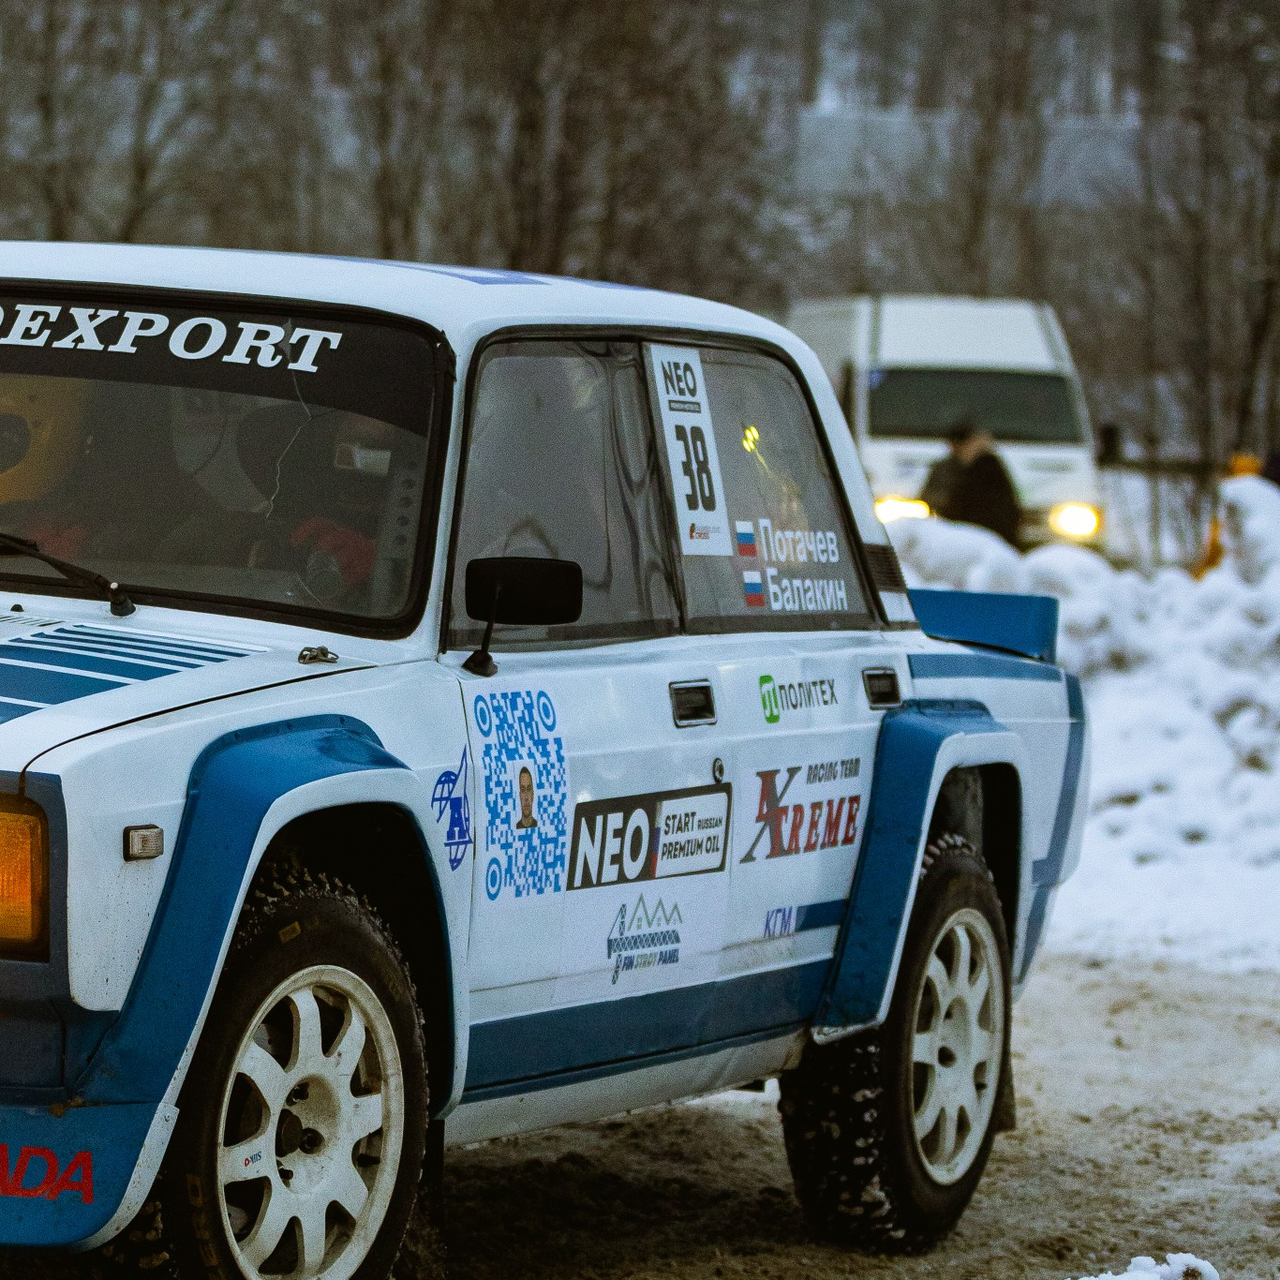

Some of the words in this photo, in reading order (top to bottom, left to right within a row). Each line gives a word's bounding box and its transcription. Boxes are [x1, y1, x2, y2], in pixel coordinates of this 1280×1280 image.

[661, 360, 697, 398] NEO
[674, 424, 716, 512] 38
[758, 518, 840, 563] Потачев
[765, 567, 848, 611] Балакин
[778, 678, 839, 711] ПОЛИТЕХ
[806, 760, 838, 785] RACING
[840, 757, 861, 781] TEAM
[573, 807, 650, 888] NEO
[664, 811, 696, 836] START
[697, 817, 723, 831] RUSSIAN
[661, 838, 705, 861] PREMIUM
[705, 835, 721, 853] OIL
